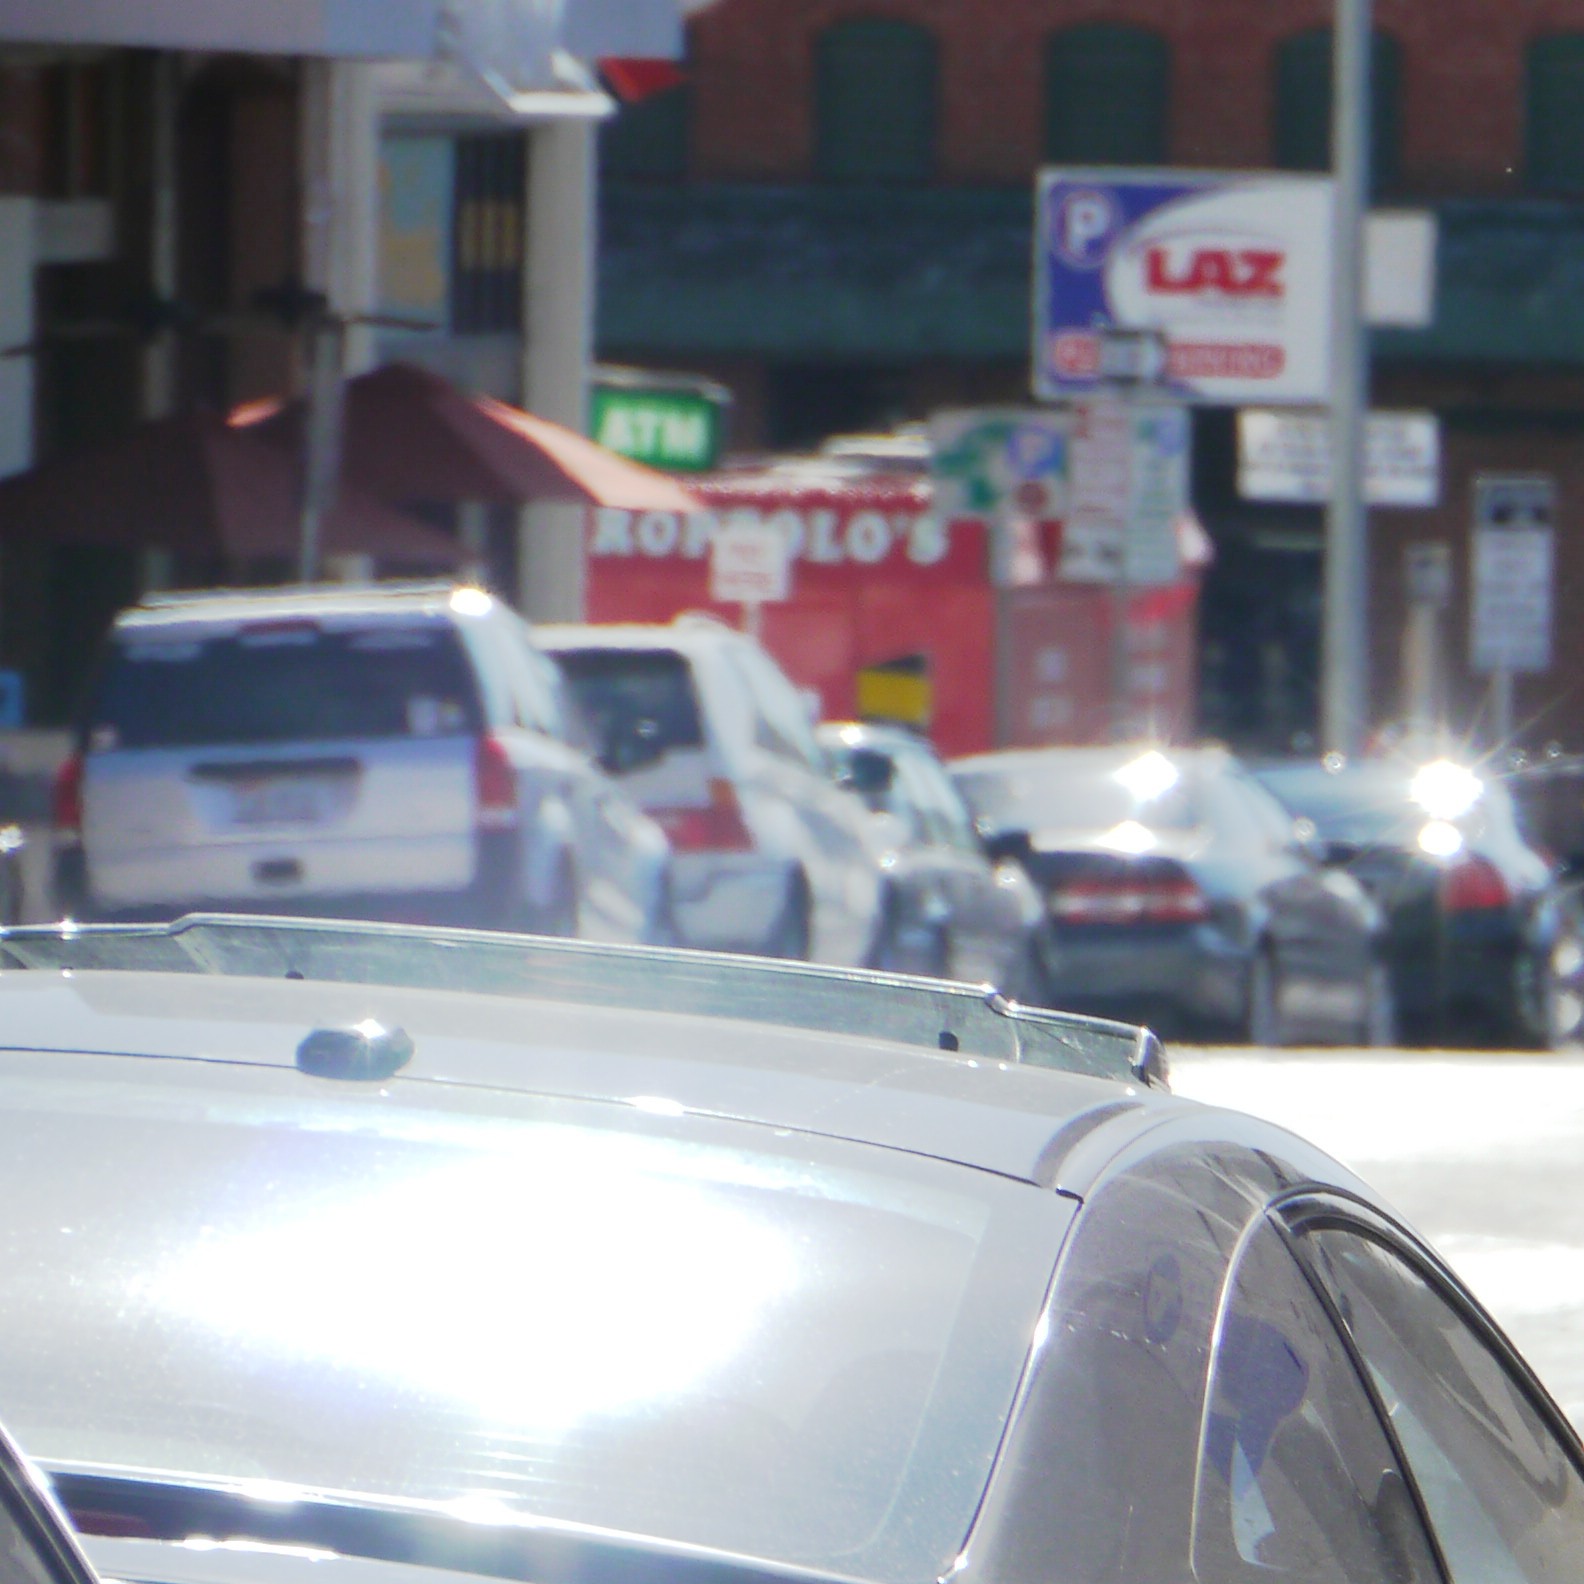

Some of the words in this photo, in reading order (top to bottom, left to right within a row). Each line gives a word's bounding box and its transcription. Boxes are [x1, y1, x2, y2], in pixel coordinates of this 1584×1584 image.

[1065, 198, 1110, 256] P
[1146, 245, 1288, 296] LAZ
[600, 403, 709, 459] ATM
